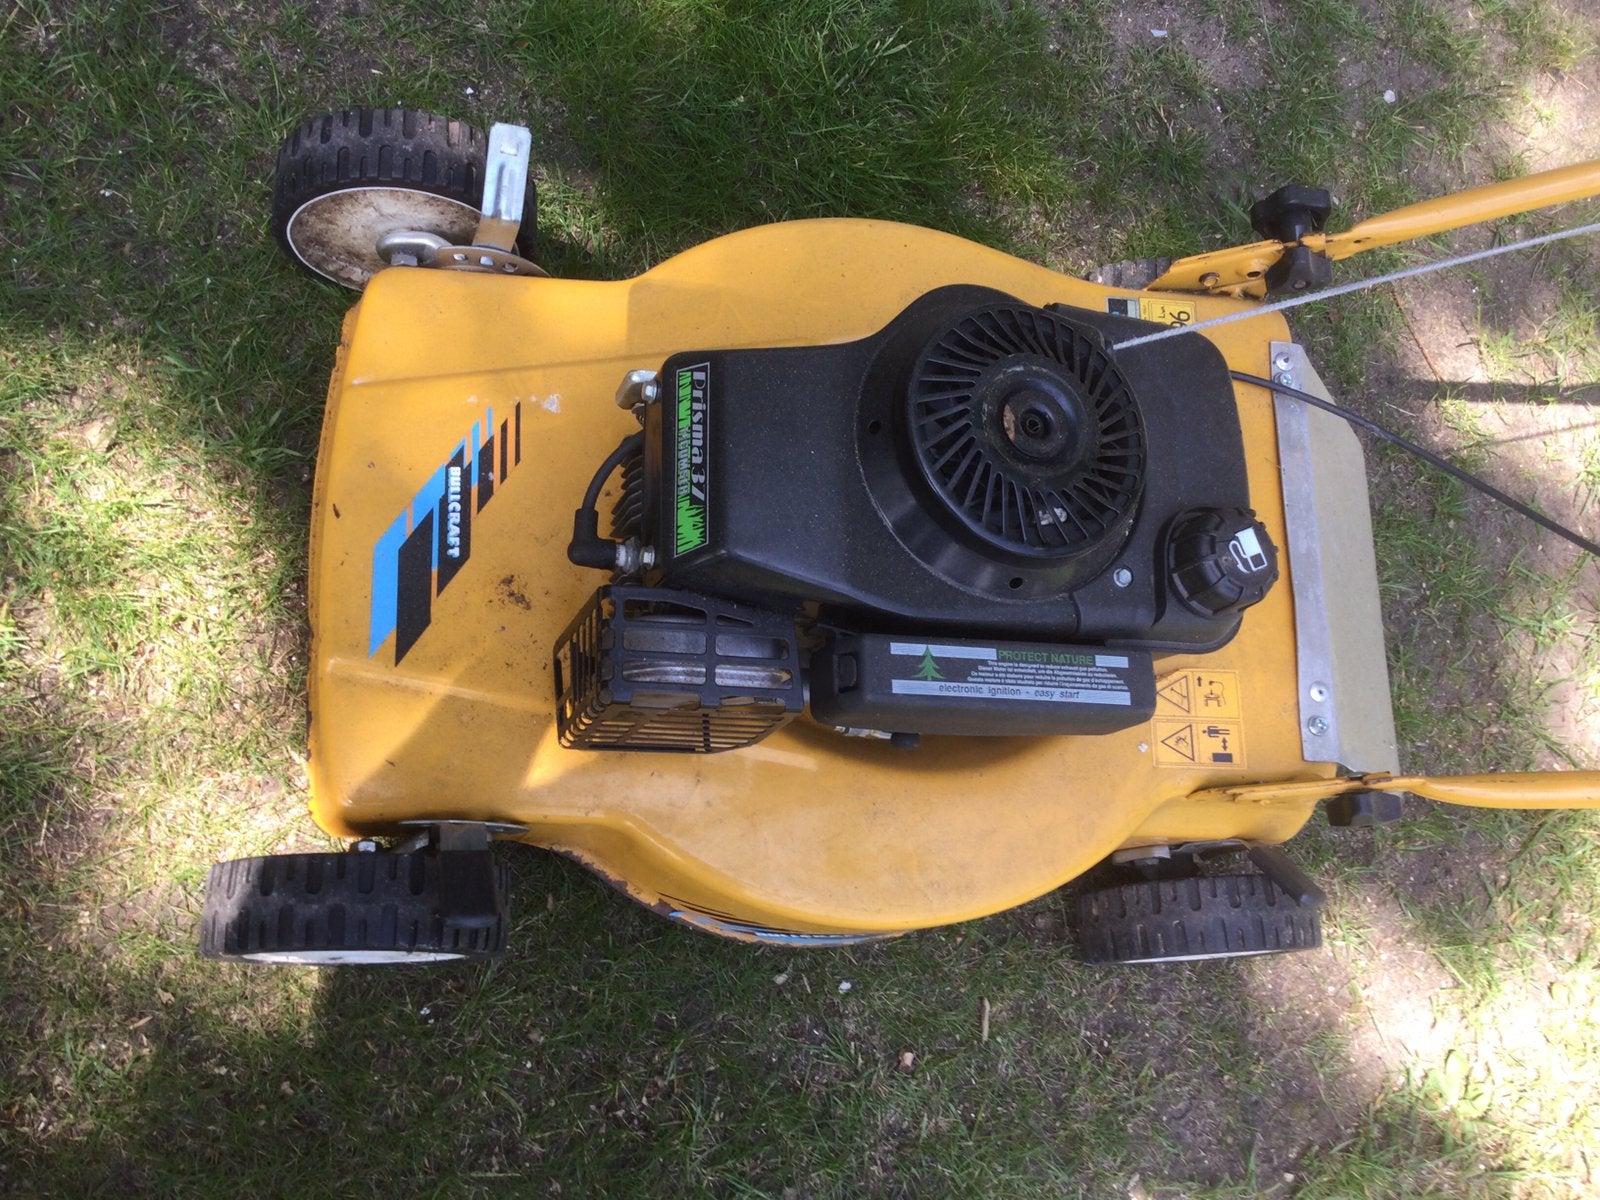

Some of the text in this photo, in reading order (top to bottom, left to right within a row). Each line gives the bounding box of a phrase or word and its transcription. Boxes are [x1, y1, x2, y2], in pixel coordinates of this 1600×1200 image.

[691, 371, 707, 465] Prisma
[447, 466, 462, 558] BULLCRAFT
[999, 650, 1094, 665] PROTECT NATURE
[938, 684, 983, 694] electronic
[988, 686, 1022, 697] ignition
[1034, 689, 1056, 699] easy
[1059, 690, 1080, 699] start
